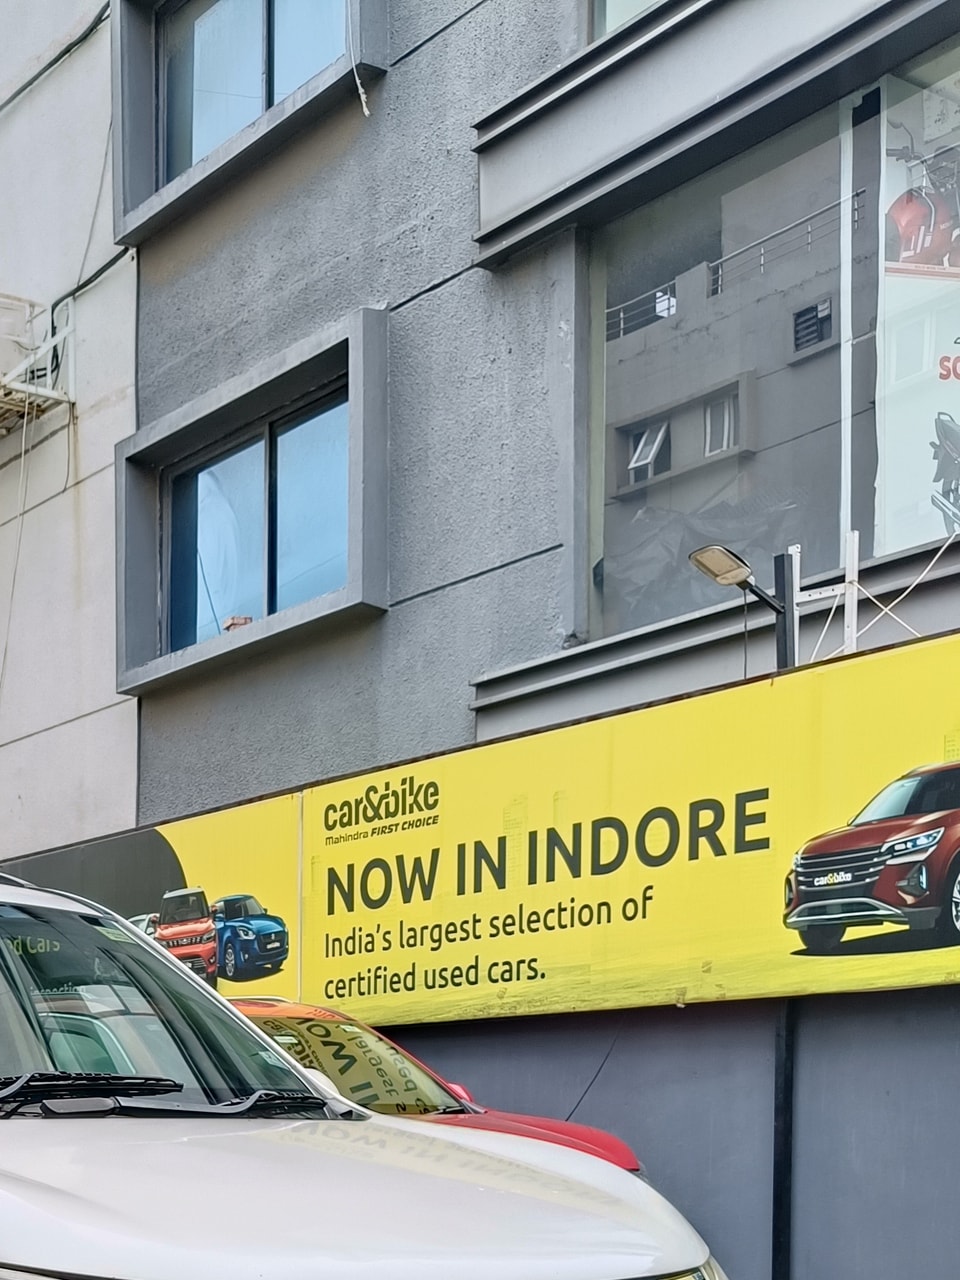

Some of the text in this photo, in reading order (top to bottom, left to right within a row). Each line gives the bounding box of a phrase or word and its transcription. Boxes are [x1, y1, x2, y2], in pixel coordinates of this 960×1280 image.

[324, 776, 440, 831] car&bike
[324, 814, 439, 846] Mahindra FIRST CHOICE
[327, 788, 771, 916] NOW IN INDORE
[324, 885, 654, 959] India's largest selection of
[324, 955, 547, 999] certified used cars.
